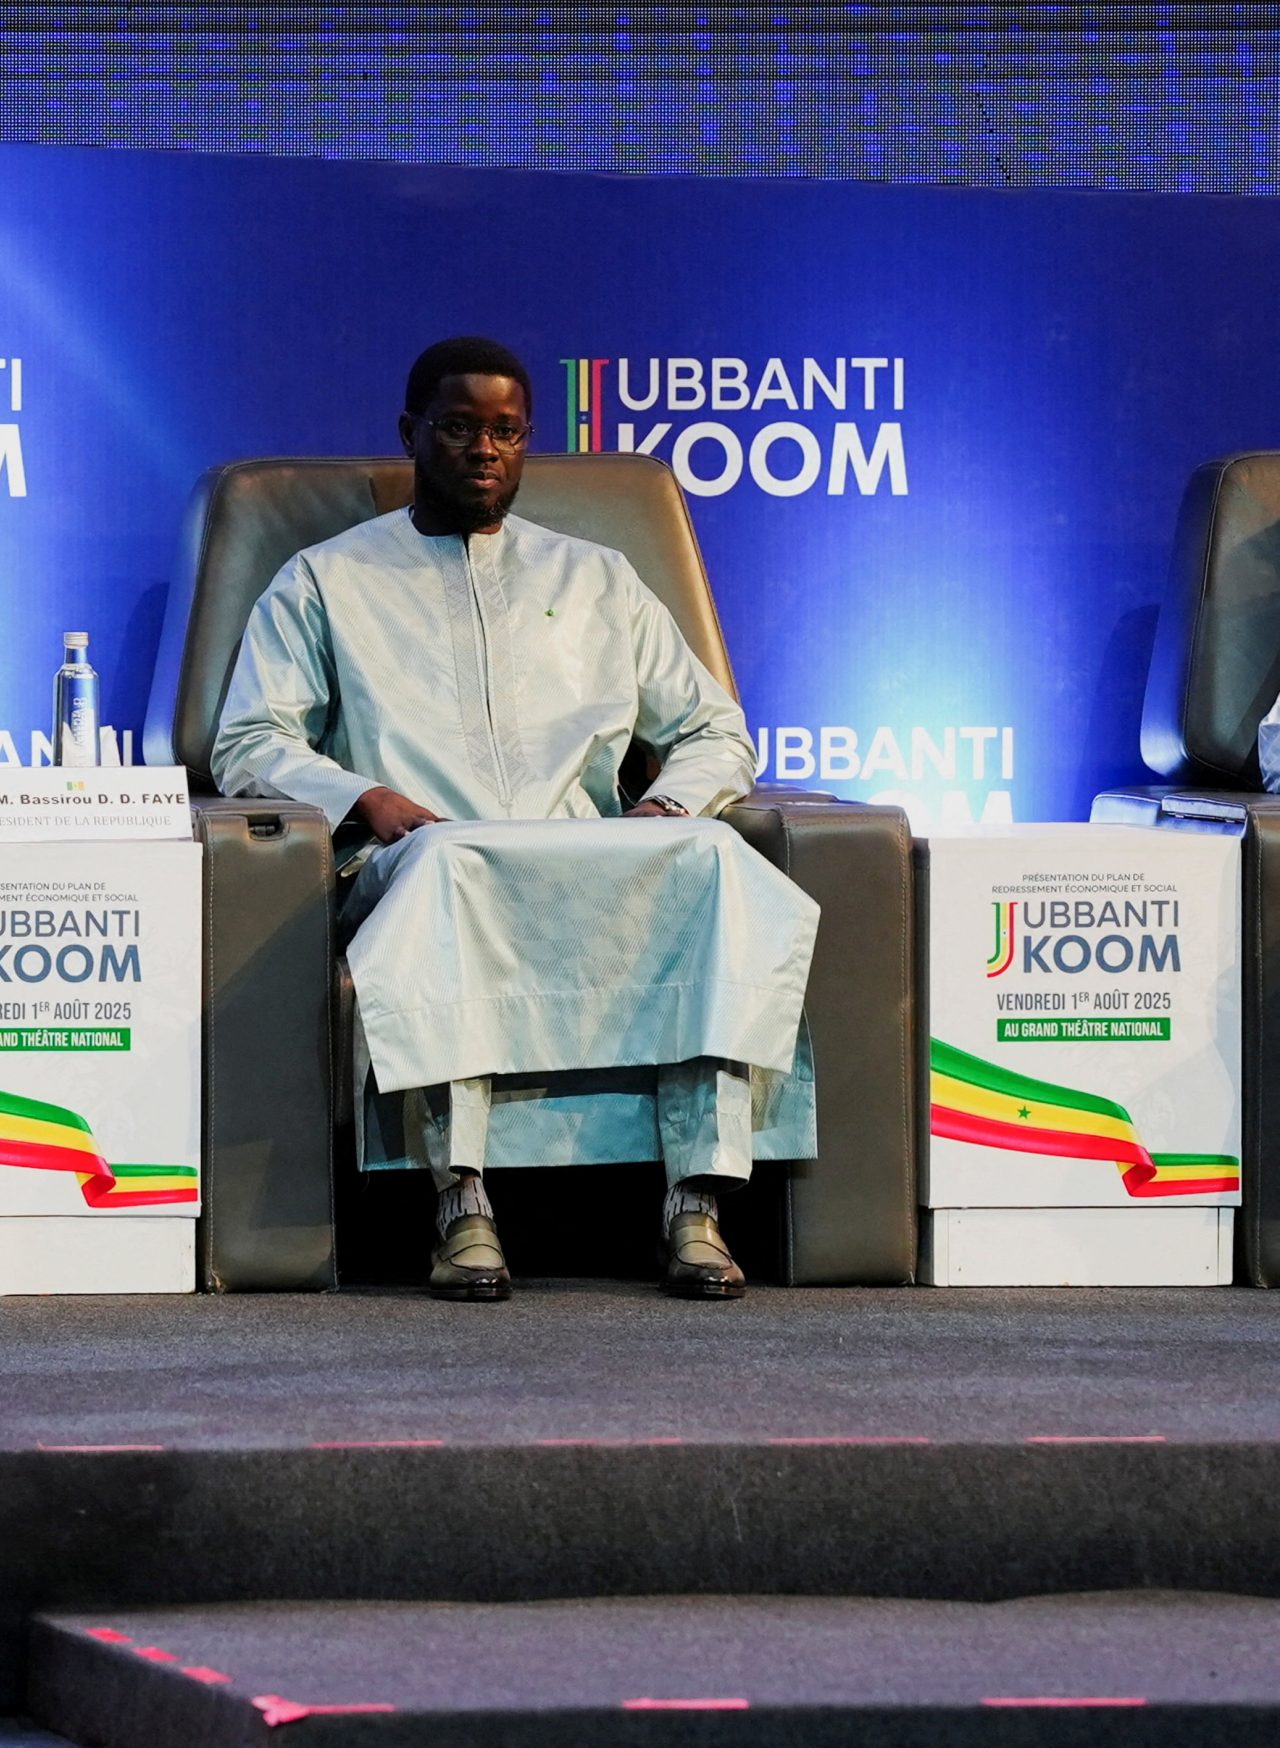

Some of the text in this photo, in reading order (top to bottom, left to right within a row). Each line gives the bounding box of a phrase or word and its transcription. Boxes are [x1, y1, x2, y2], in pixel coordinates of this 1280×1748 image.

[20, 794, 92, 805] Bassirou
[98, 794, 113, 804] D.
[120, 794, 136, 804] D.
[142, 793, 186, 804] FAYE
[55, 816, 70, 826] DE
[75, 816, 90, 826] LA
[1022, 873, 1089, 882] PRÉSENTATION
[1132, 873, 1145, 881] DE
[52, 883, 65, 891] DU
[68, 883, 92, 891] PLAN
[992, 885, 1062, 894] REDRESSEMENT
[1065, 884, 1129, 894] ÉCONOMIQUE
[26, 893, 90, 903] ÉCONOMIQUE
[92, 894, 102, 902] ET
[104, 894, 139, 902] SOCIAL
[1023, 934, 1181, 974] KOOM
[997, 993, 1065, 1011] VENDREDI
[1093, 989, 1130, 1010] AOÛT
[1134, 992, 1171, 1010] 2025
[53, 999, 90, 1020] AOÛT
[94, 1002, 131, 1020] 2025
[1004, 1019, 1163, 1037] AU GRAND THÉÂTRE NATIONAL
[21, 1029, 68, 1047] THÉÂTRE
[71, 1032, 123, 1046] NATIONAL
